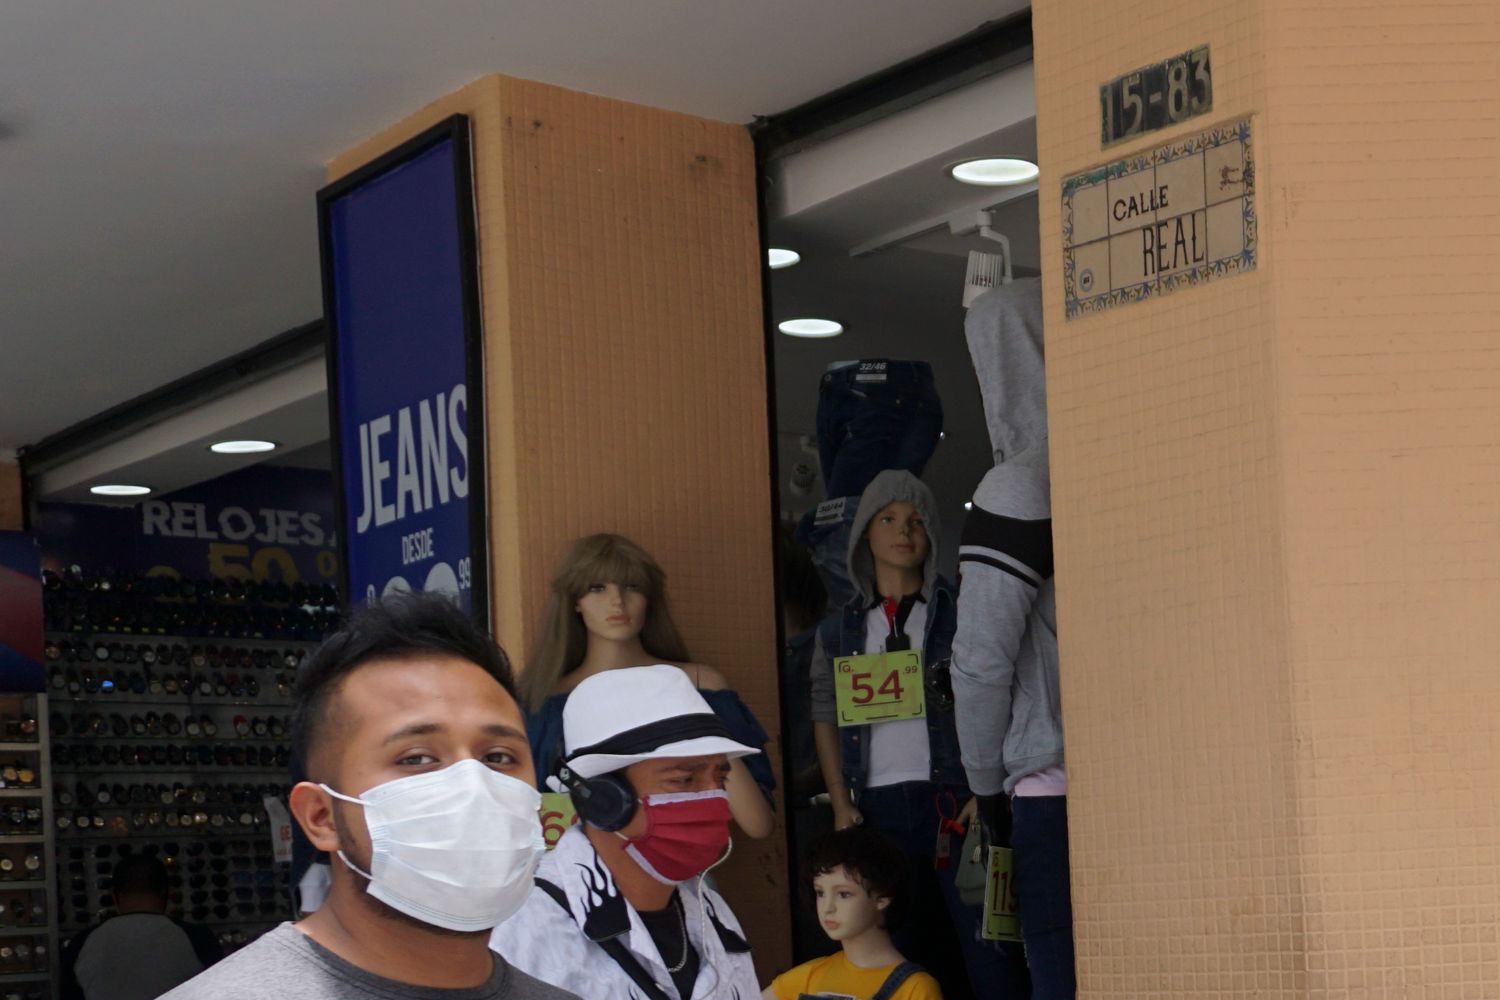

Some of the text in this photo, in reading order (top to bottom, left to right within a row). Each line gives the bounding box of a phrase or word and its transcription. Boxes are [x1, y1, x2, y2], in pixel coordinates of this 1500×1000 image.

[1102, 49, 1211, 141] 15-83
[1113, 185, 1169, 221] CALLE
[1142, 213, 1205, 276] REAL
[357, 383, 469, 534] JEANS
[142, 500, 325, 546] RELOJES
[402, 528, 434, 565] DESDE
[851, 669, 904, 704] 54
